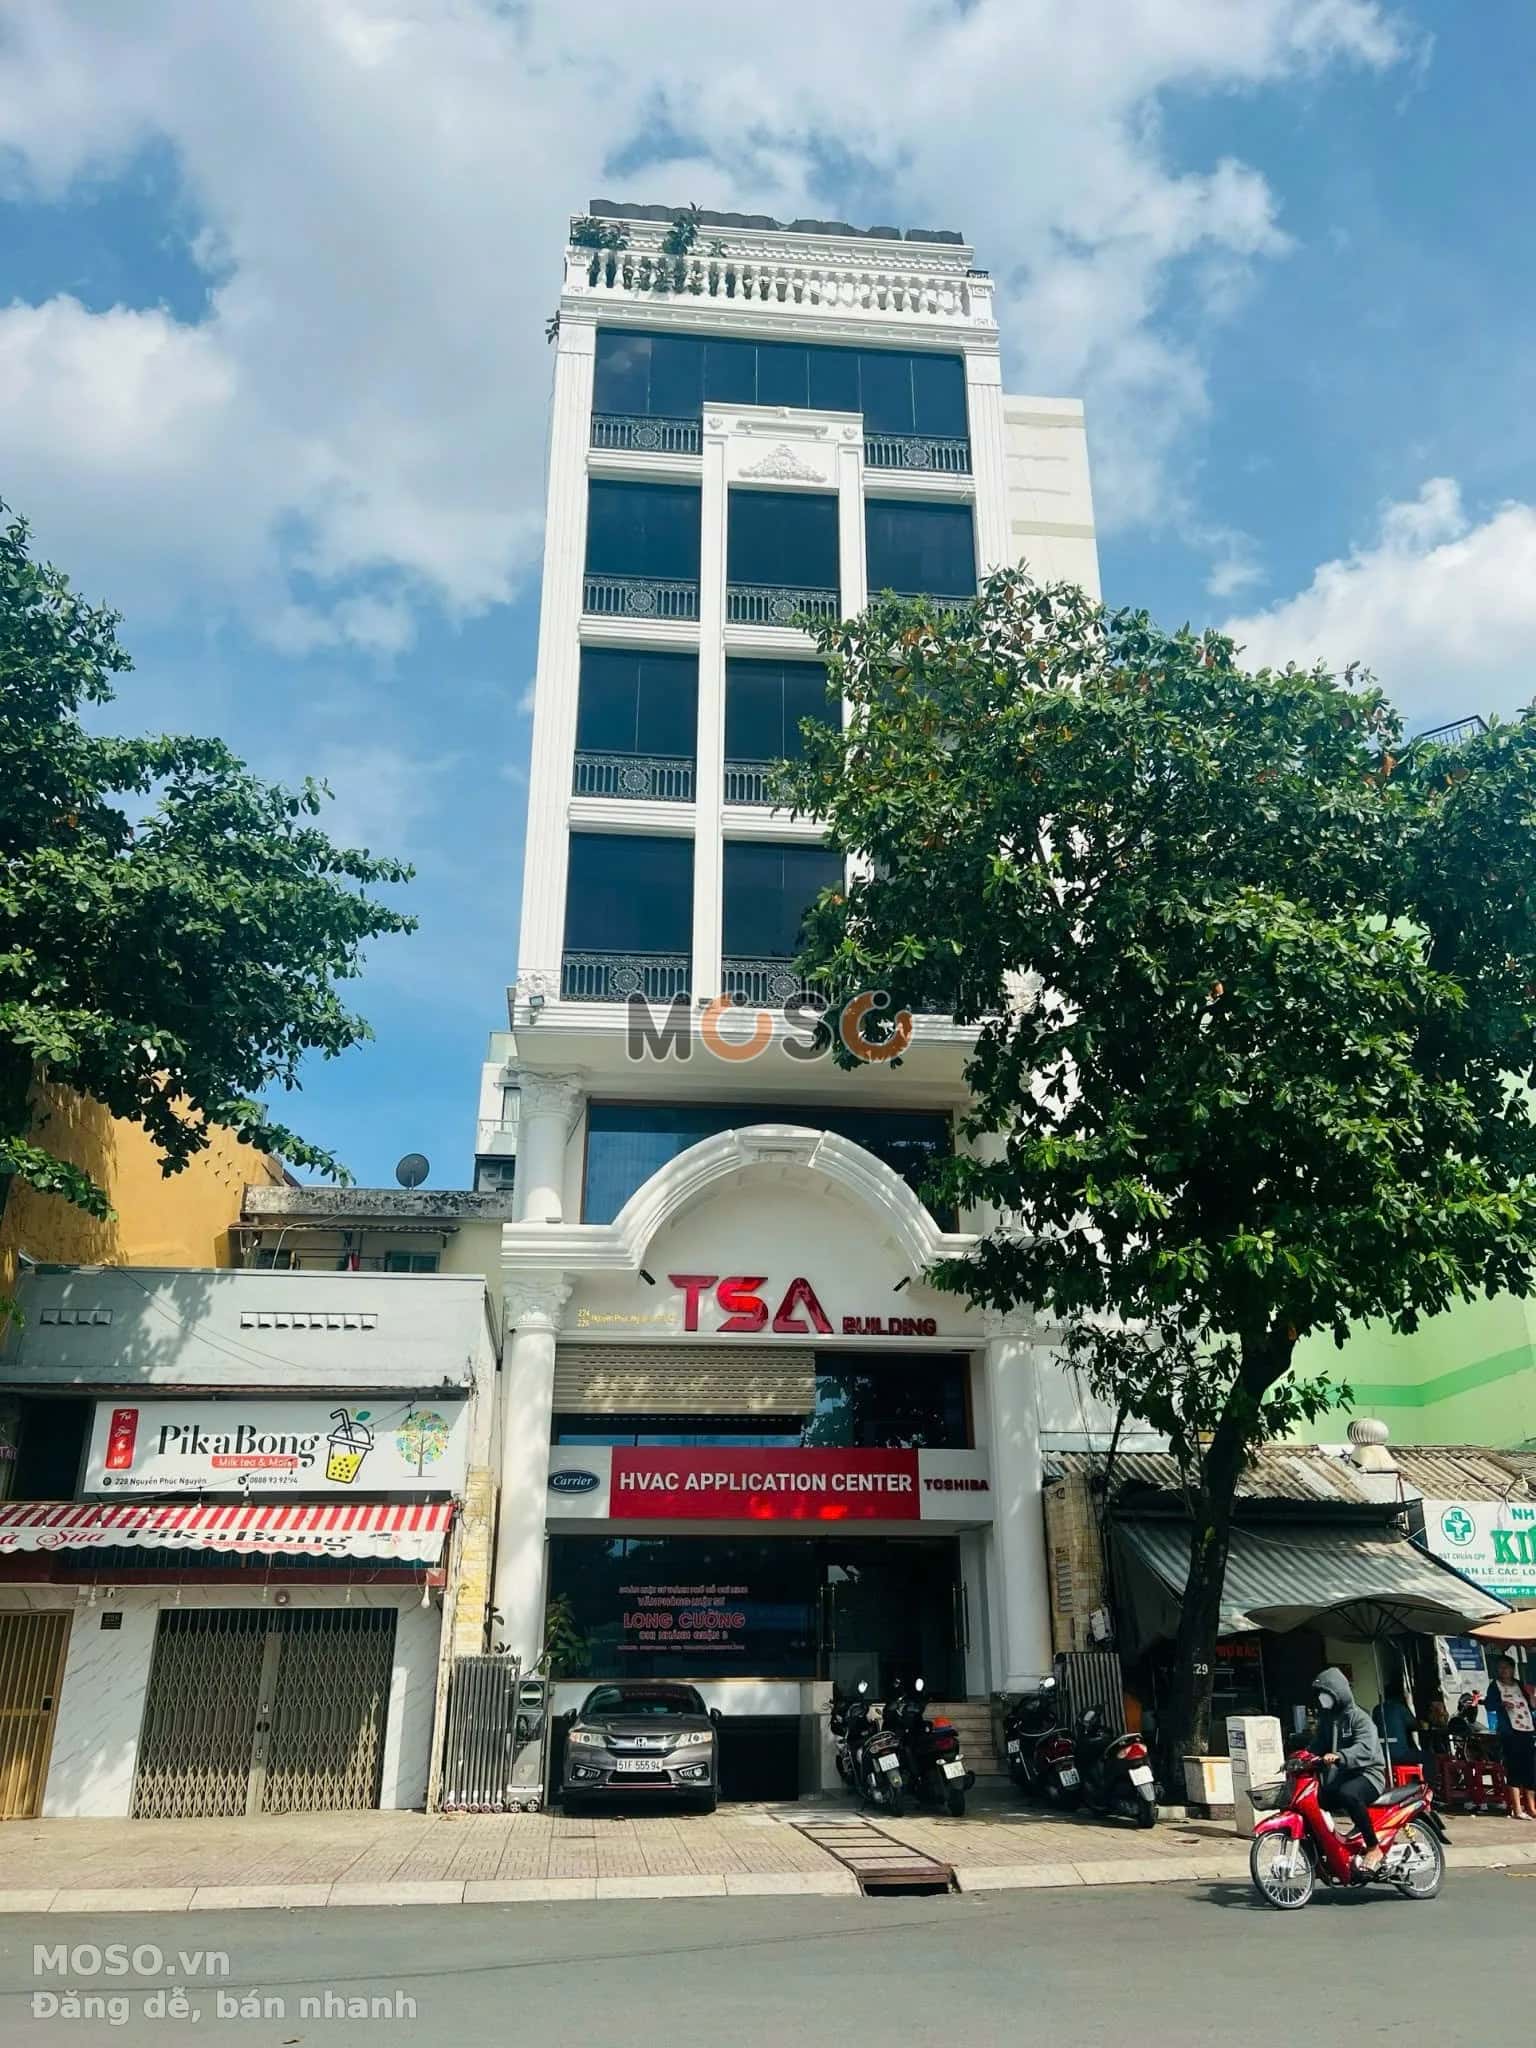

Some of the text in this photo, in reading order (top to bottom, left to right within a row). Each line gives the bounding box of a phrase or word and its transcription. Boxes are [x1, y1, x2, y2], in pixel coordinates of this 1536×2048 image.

[668, 1274, 835, 1334] TSA
[842, 1317, 937, 1336] BUILDING
[552, 1474, 595, 1487] Carrier
[620, 1472, 912, 1492] HVAC APPLICATION CENTER
[924, 1478, 990, 1491] TOSHIBA
[624, 1612, 673, 1629] LONG
